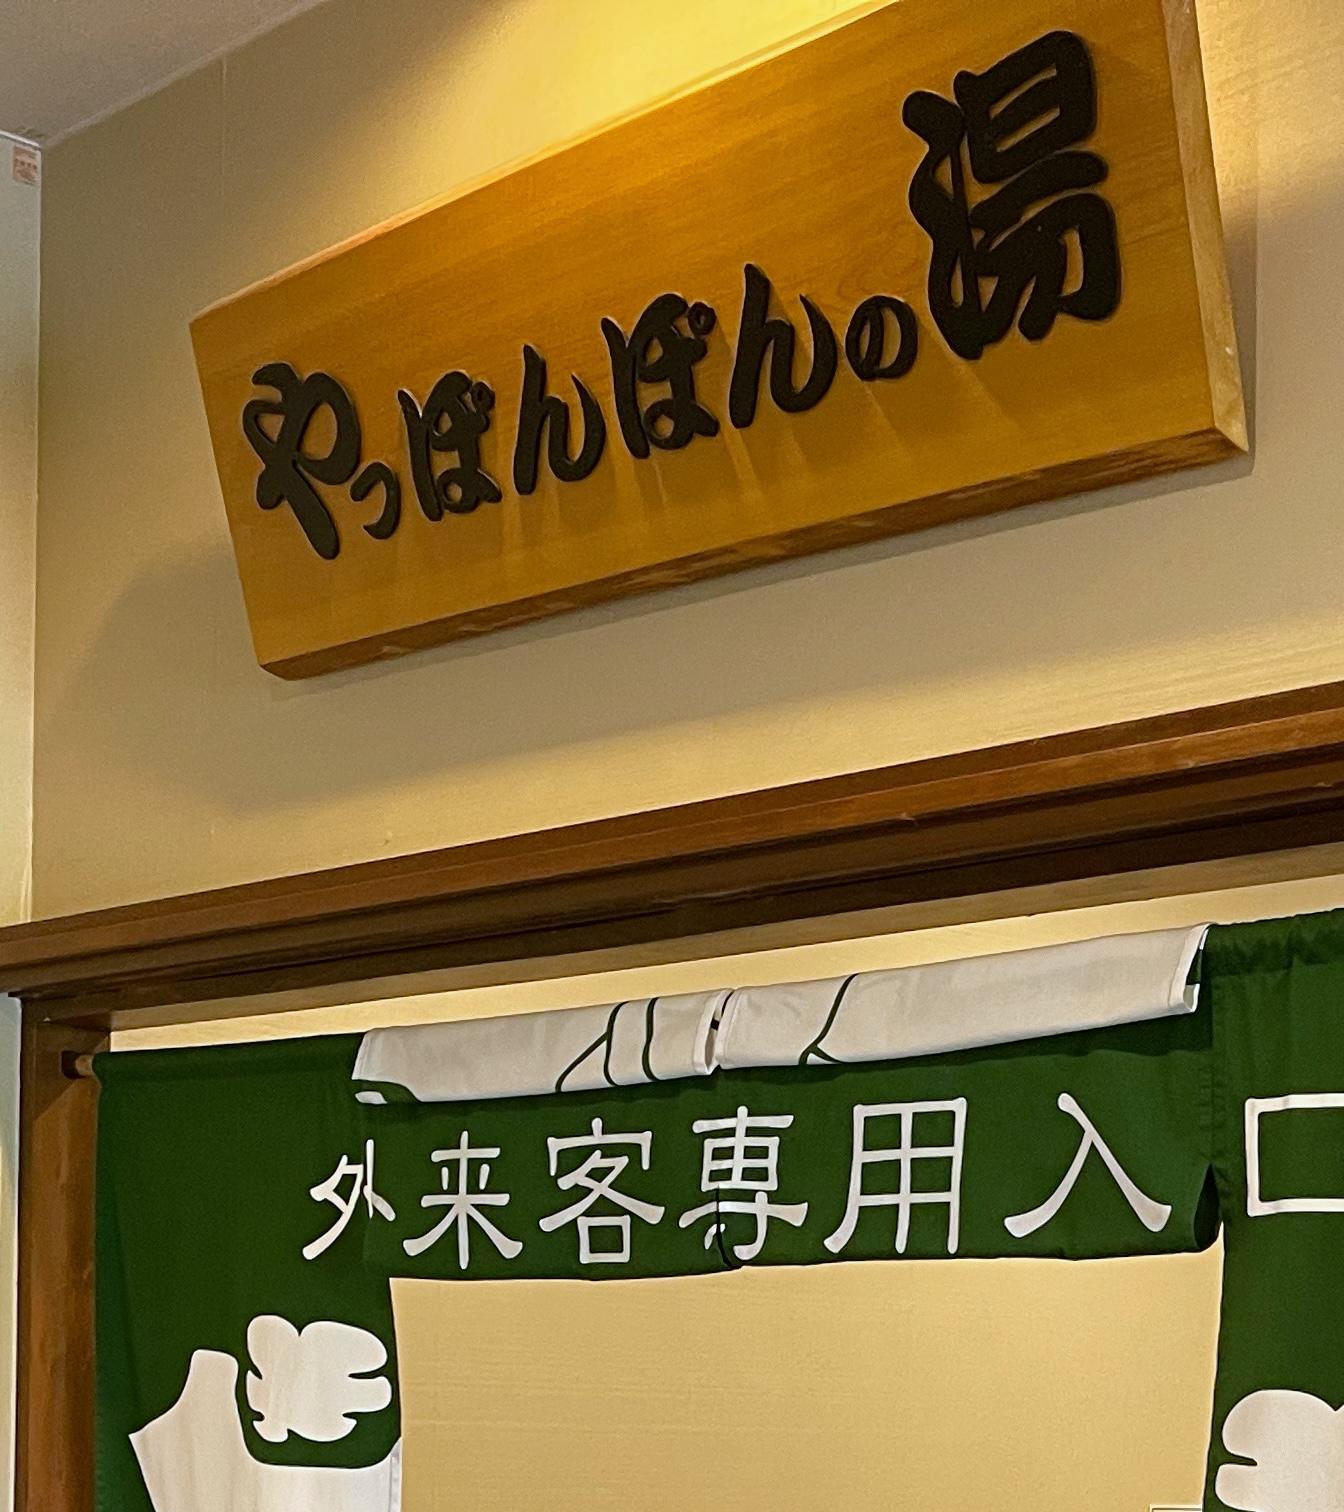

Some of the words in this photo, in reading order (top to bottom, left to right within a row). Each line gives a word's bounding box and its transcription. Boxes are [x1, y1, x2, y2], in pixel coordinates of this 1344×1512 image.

[243, 30, 1121, 560] やっぽんぽんの湯
